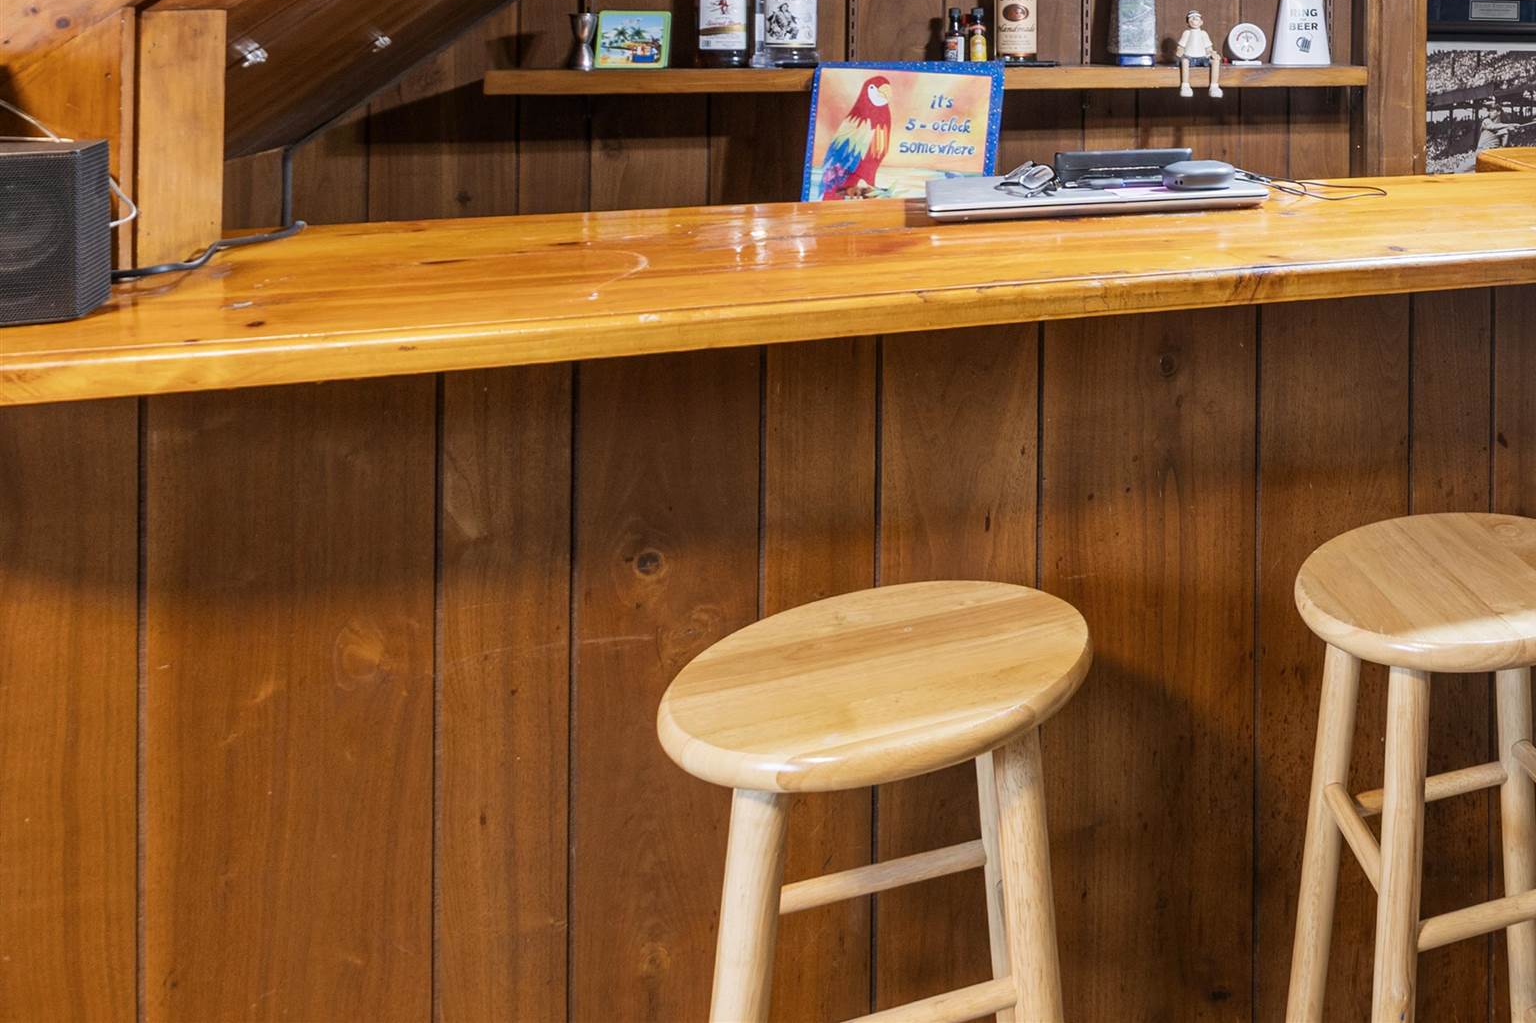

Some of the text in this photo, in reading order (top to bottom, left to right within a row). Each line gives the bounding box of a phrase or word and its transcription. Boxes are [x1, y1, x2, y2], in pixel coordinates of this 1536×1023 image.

[1289, 8, 1318, 18] RING
[1288, 22, 1319, 32] BEER
[930, 94, 954, 110] it's
[905, 117, 917, 132] 5
[931, 116, 972, 134] o'clock
[898, 140, 977, 156] somewhere
